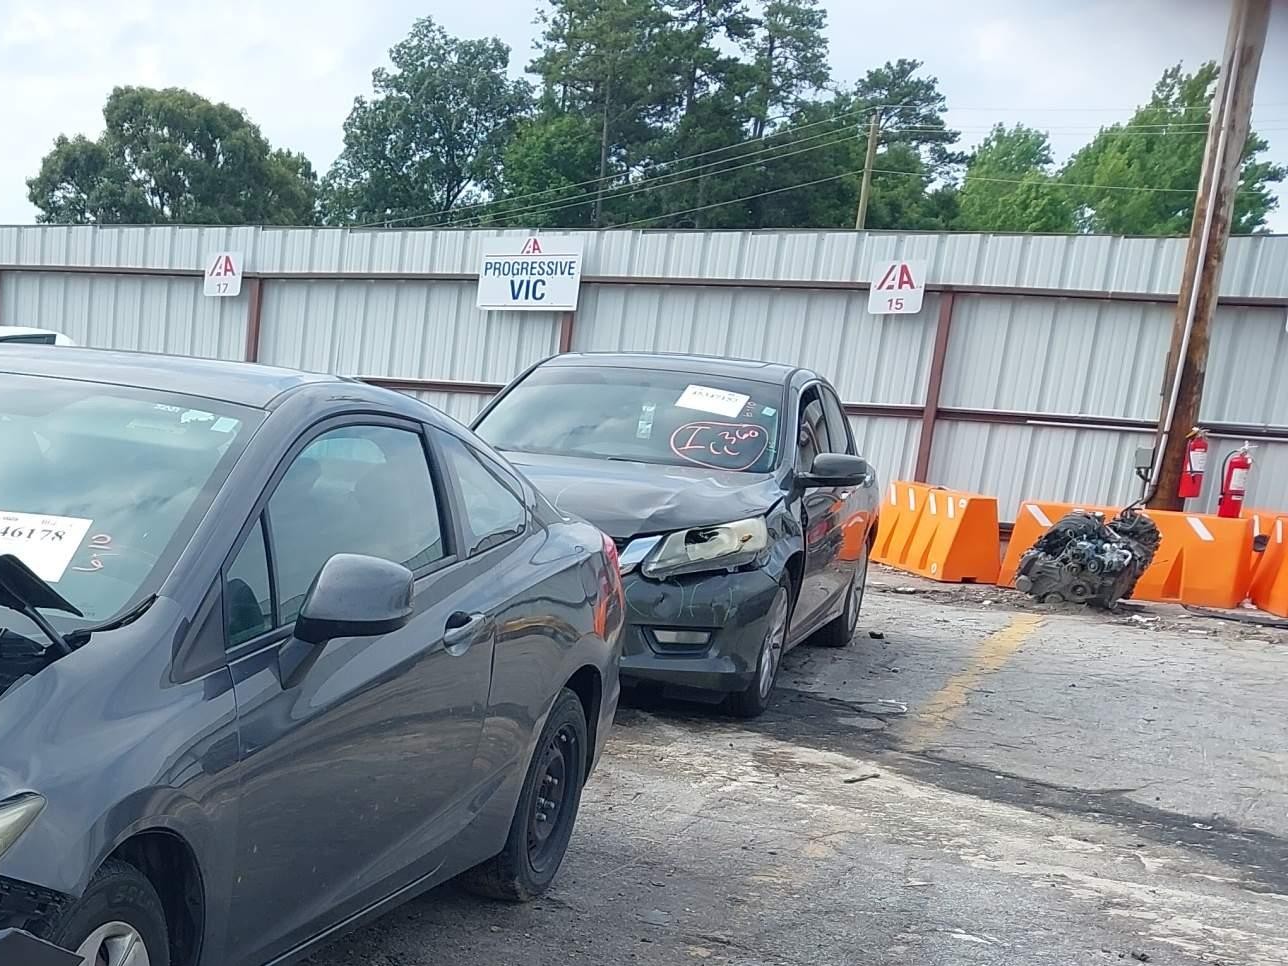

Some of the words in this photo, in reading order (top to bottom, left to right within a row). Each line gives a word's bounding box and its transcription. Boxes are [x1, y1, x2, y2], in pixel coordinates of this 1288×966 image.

[484, 261, 577, 276] PROGRESSIVE
[216, 282, 229, 293] 17
[510, 279, 546, 301] VIC
[888, 298, 904, 311] 15
